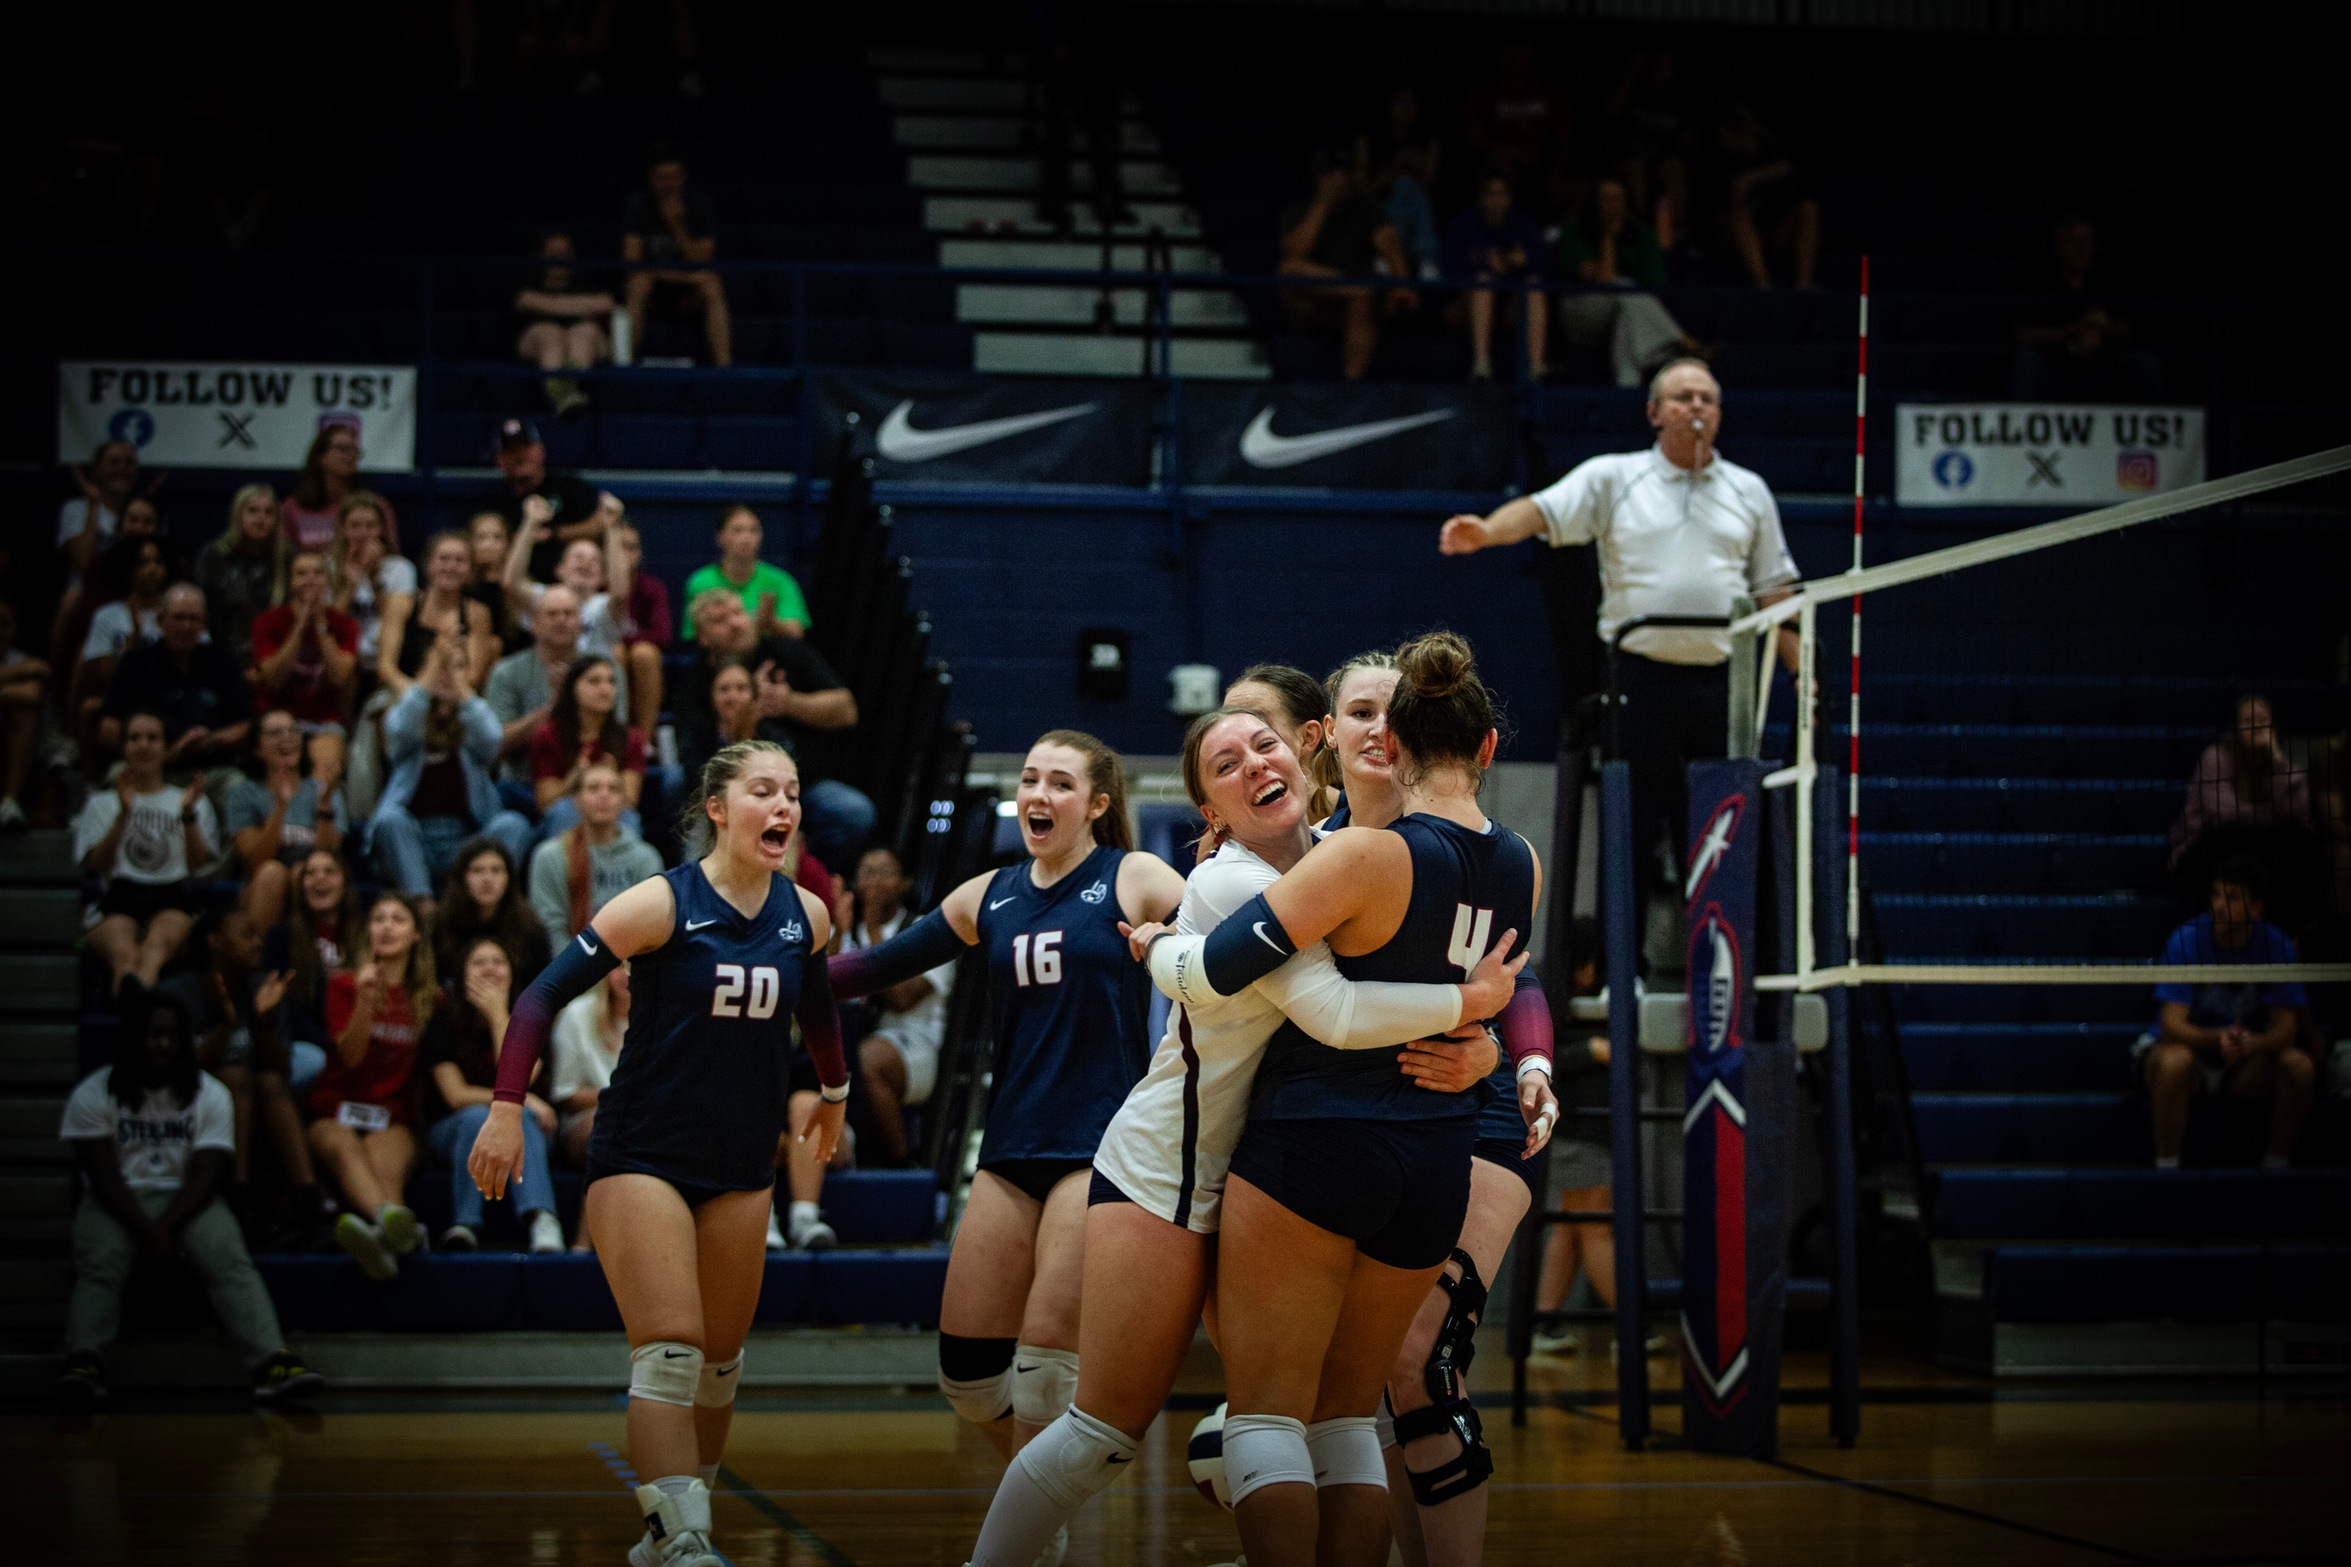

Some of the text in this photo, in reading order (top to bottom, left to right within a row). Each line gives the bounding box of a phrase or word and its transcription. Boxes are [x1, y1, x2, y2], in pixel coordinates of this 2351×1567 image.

[88, 367, 393, 411] FOLLOW US!
[1914, 412, 2184, 449] FOLLOW US!
[1012, 929, 1063, 989] 16
[1446, 902, 1496, 983] 4
[710, 962, 780, 1020] 20
